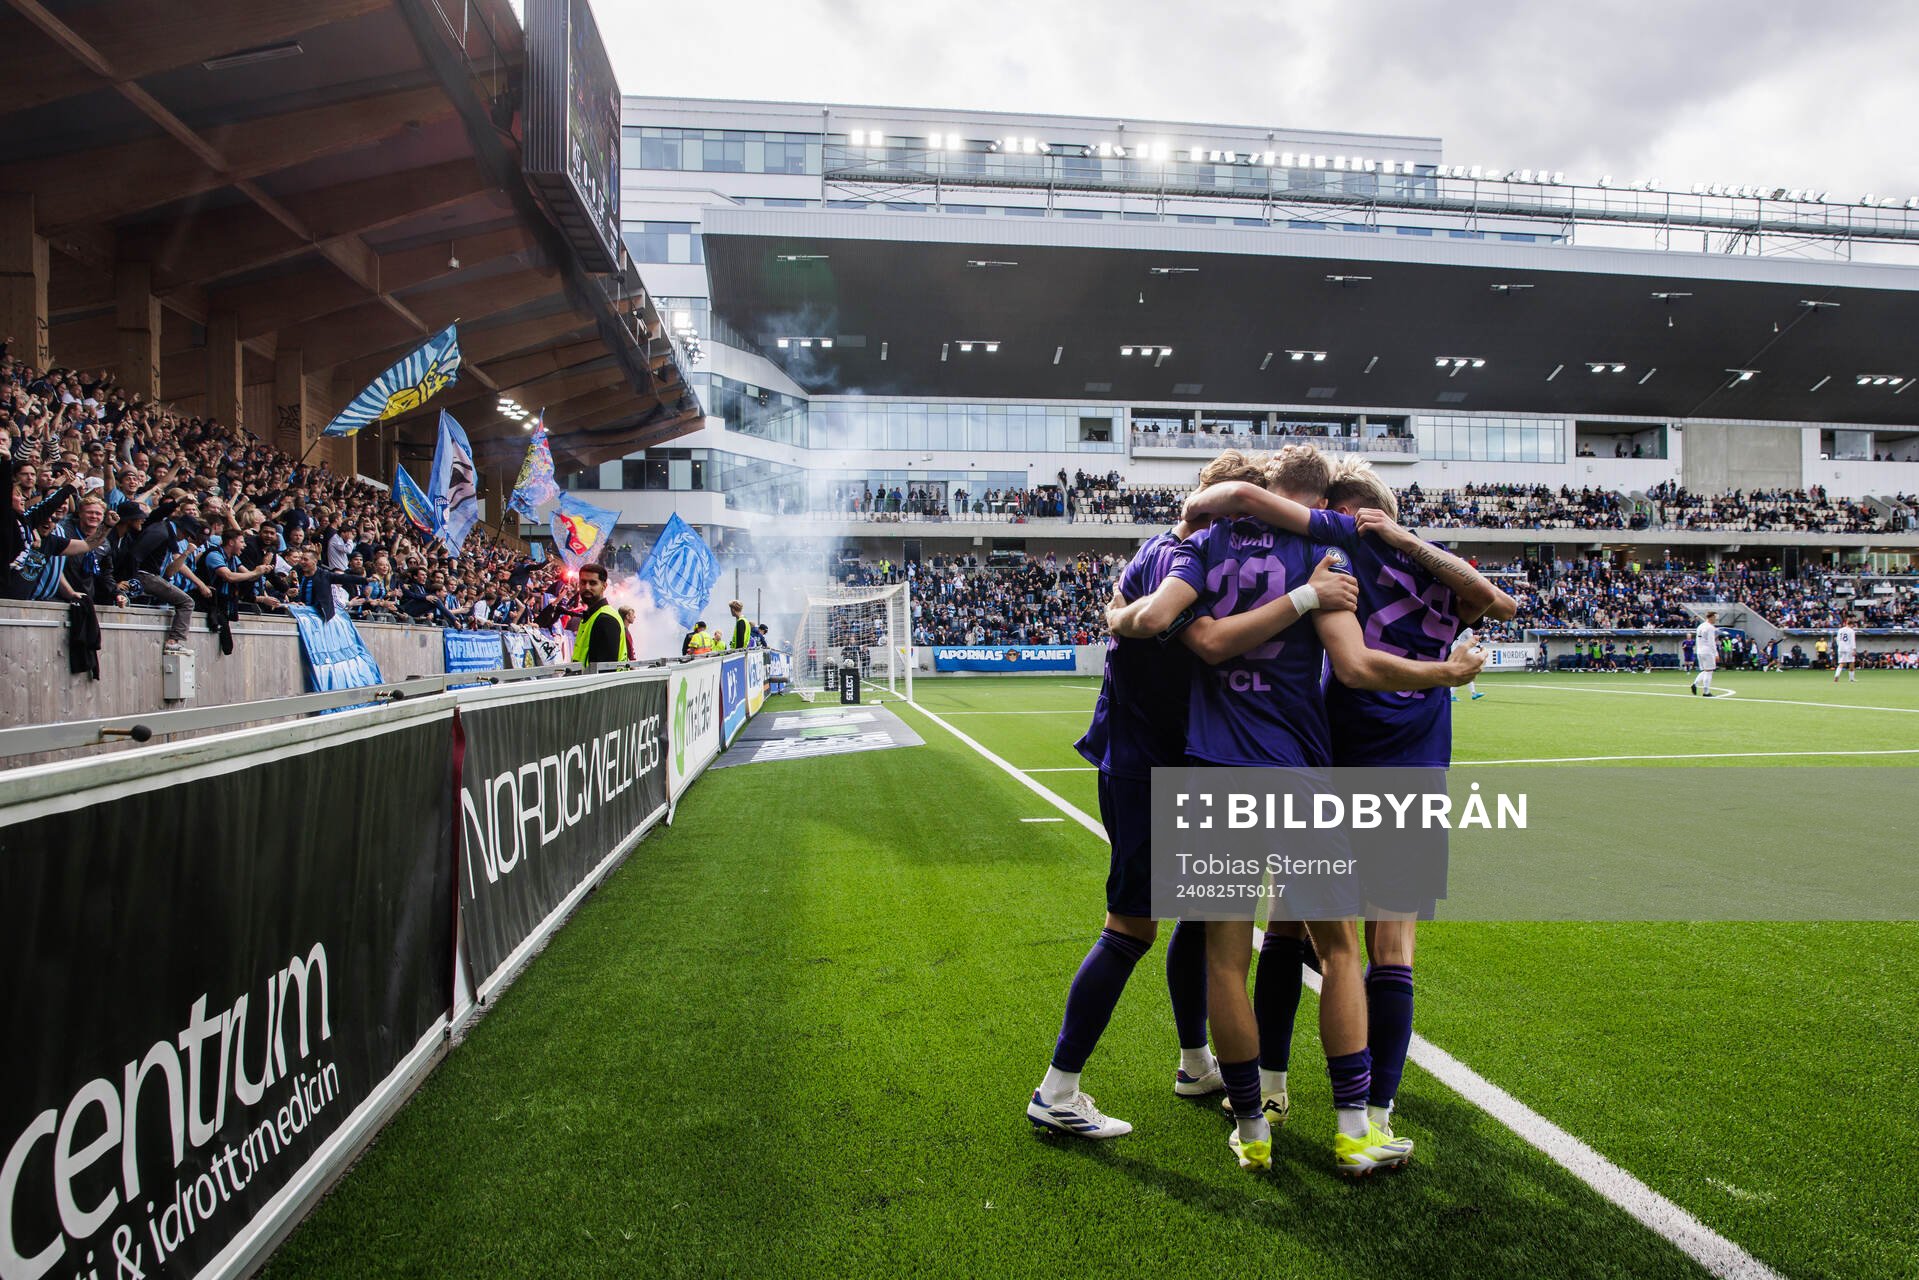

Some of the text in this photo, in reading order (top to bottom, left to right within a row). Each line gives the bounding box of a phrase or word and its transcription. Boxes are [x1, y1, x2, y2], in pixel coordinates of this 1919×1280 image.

[1206, 554, 1286, 660] 22
[939, 649, 1073, 660] APORNAS PLANET
[1502, 650, 1529, 659] NORDISK
[845, 675, 854, 701] SELECT
[1215, 670, 1272, 692] TCL
[0, 942, 331, 1280] centrum
[112, 1059, 340, 1280] & idrottsmedicin
